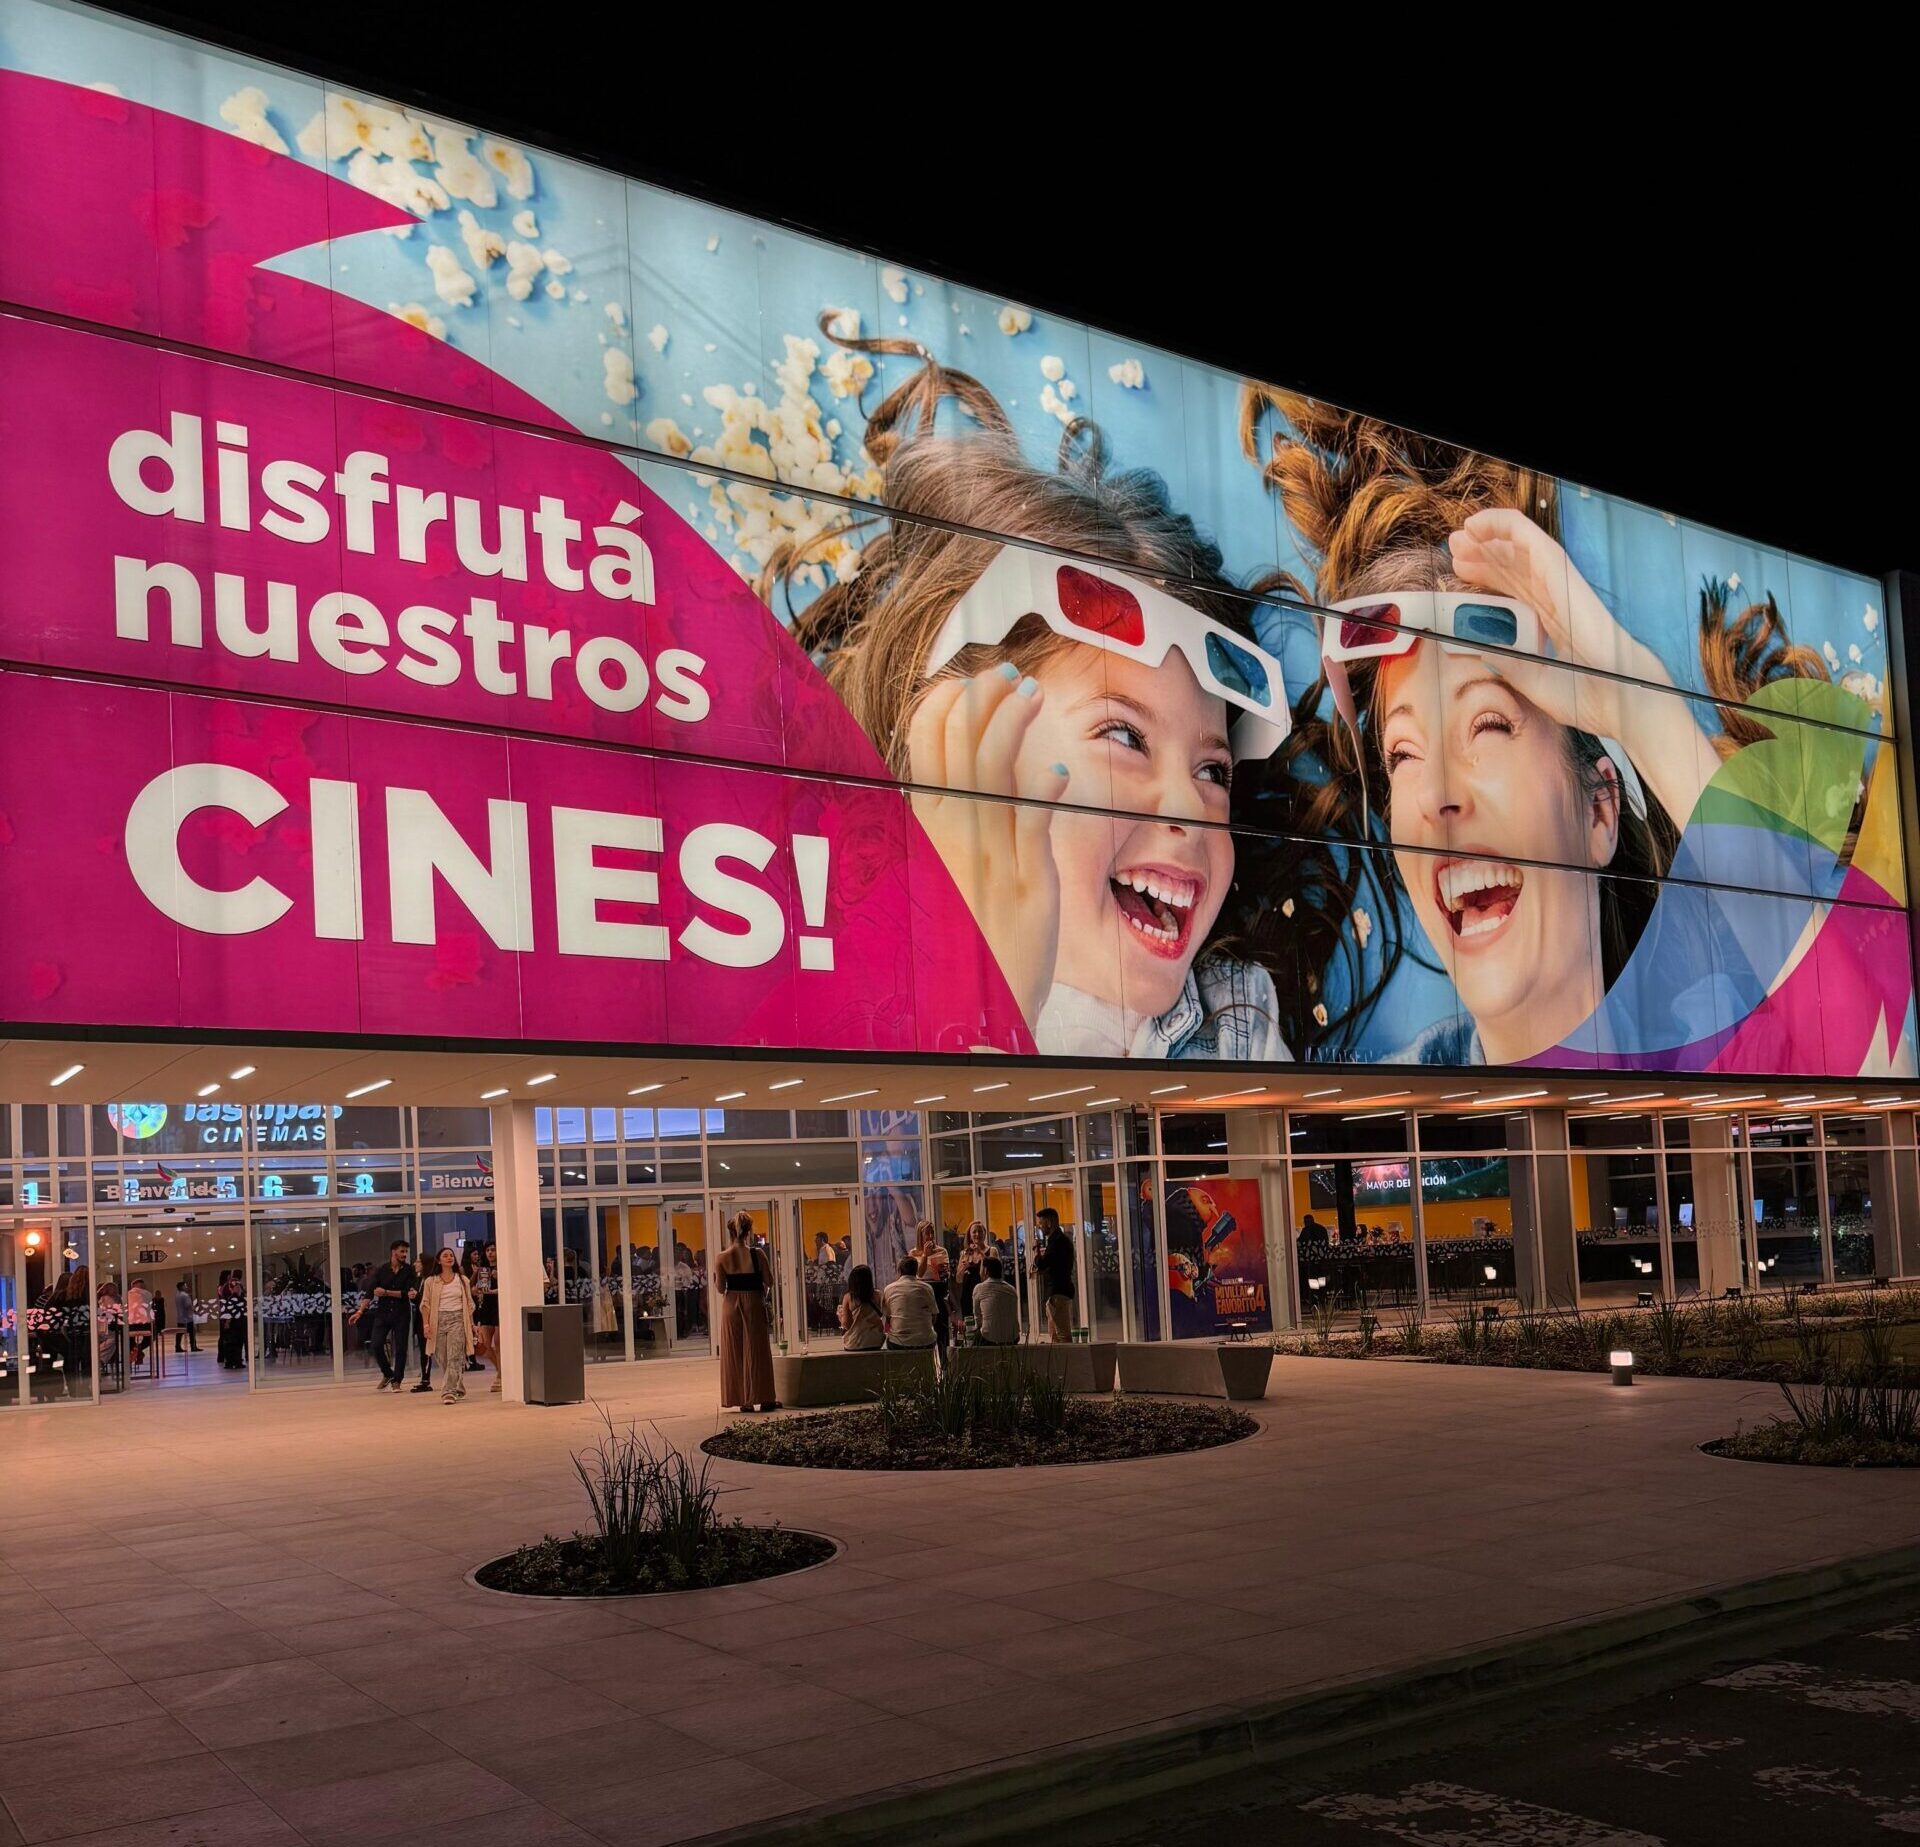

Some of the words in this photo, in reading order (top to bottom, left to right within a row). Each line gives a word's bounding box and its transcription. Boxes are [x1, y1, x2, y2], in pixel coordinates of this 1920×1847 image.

[109, 411, 655, 606] disfrutá
[115, 555, 710, 723] nuestros
[126, 763, 835, 971] CINES!
[203, 1125, 327, 1144] CINEMAS
[23, 1182, 38, 1205] 1
[263, 1175, 284, 1197] 6
[312, 1175, 328, 1196] 7
[355, 1173, 374, 1194] 8
[106, 1181, 233, 1199] Benvenidos
[431, 1174, 544, 1189] Bienves
[1366, 1180, 1394, 1191] MAYOR
[1396, 1174, 1447, 1188] DEICIÓN
[1216, 1297, 1256, 1315] FAVORITO
[1255, 1283, 1265, 1312] 4
